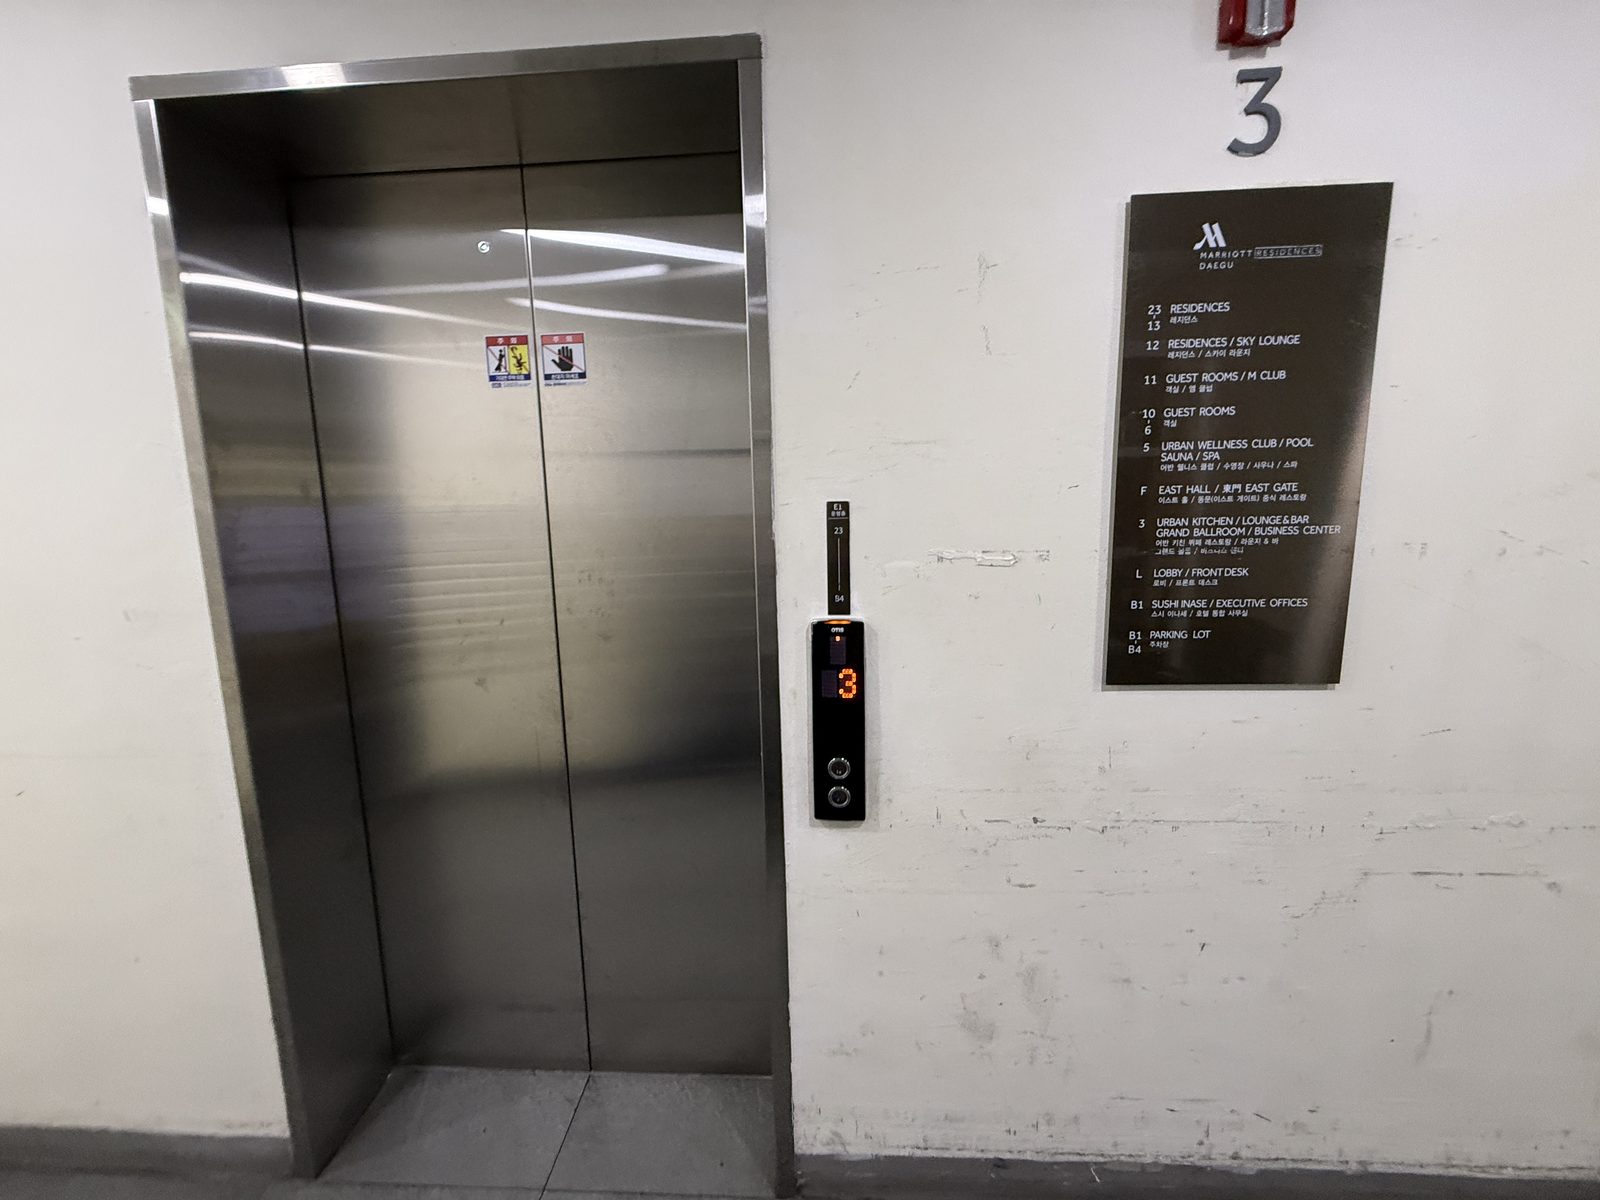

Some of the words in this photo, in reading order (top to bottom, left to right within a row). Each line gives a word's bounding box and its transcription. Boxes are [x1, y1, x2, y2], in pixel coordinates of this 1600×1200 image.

[1227, 67, 1283, 158] 3
[1200, 250, 1253, 259] MARRIOTT
[1254, 247, 1322, 257] RESIDENCES
[1199, 261, 1234, 270] DAEGU
[1148, 304, 1162, 315] 23
[1170, 302, 1230, 314] RESIDENCES
[1148, 321, 1160, 331] 13
[1146, 340, 1159, 350] 12
[1168, 337, 1227, 349] RESIDENCES
[1236, 336, 1255, 346] SKY
[1259, 335, 1300, 346] LOUNGE
[1144, 376, 1157, 384] 11
[1166, 373, 1199, 383] GUEST
[1202, 373, 1238, 382] ROOMS
[1247, 372, 1256, 381] M
[1260, 370, 1286, 380] CLUB
[1142, 409, 1155, 419] 10
[1164, 407, 1197, 418] GUEST
[1199, 406, 1236, 416] ROOMS
[1144, 425, 1151, 435] 6
[1143, 443, 1150, 452] 5
[1162, 441, 1194, 451] URBAN
[1198, 439, 1248, 449] WELLNESS
[1252, 438, 1277, 449] CLUB
[1286, 438, 1314, 448] POOL
[1161, 452, 1193, 462] SAUNA
[1202, 451, 1220, 461] SPA
[1141, 486, 1147, 495] F
[1159, 485, 1182, 495] EAST
[1186, 484, 1210, 494] HALL
[1245, 483, 1268, 492] EAST
[1273, 482, 1298, 492] GATE
[1138, 519, 1145, 528] 3
[1157, 517, 1188, 527] URBAN
[1192, 516, 1234, 526] KITCHEN
[834, 526, 843, 534] 23
[1156, 528, 1189, 538] GRAND
[1193, 526, 1245, 537] BALLROOM
[1255, 525, 1299, 536] BUSINESS
[1303, 525, 1340, 534] CENTER
[1136, 569, 1142, 578] L
[1154, 568, 1183, 578] LOBBY
[1192, 568, 1223, 577] FRONT
[1224, 567, 1249, 576] DESK
[1131, 600, 1143, 609] B1
[1152, 599, 1178, 609] SUSHI
[1181, 599, 1207, 608] INASE
[1216, 598, 1266, 607] EXECUTIVE
[1269, 597, 1308, 606] OFFICES
[1129, 631, 1141, 640] B1
[1150, 630, 1188, 639] PARKING
[1193, 630, 1211, 639] LOT
[1128, 645, 1141, 654] B4
[838, 668, 857, 699] 3
